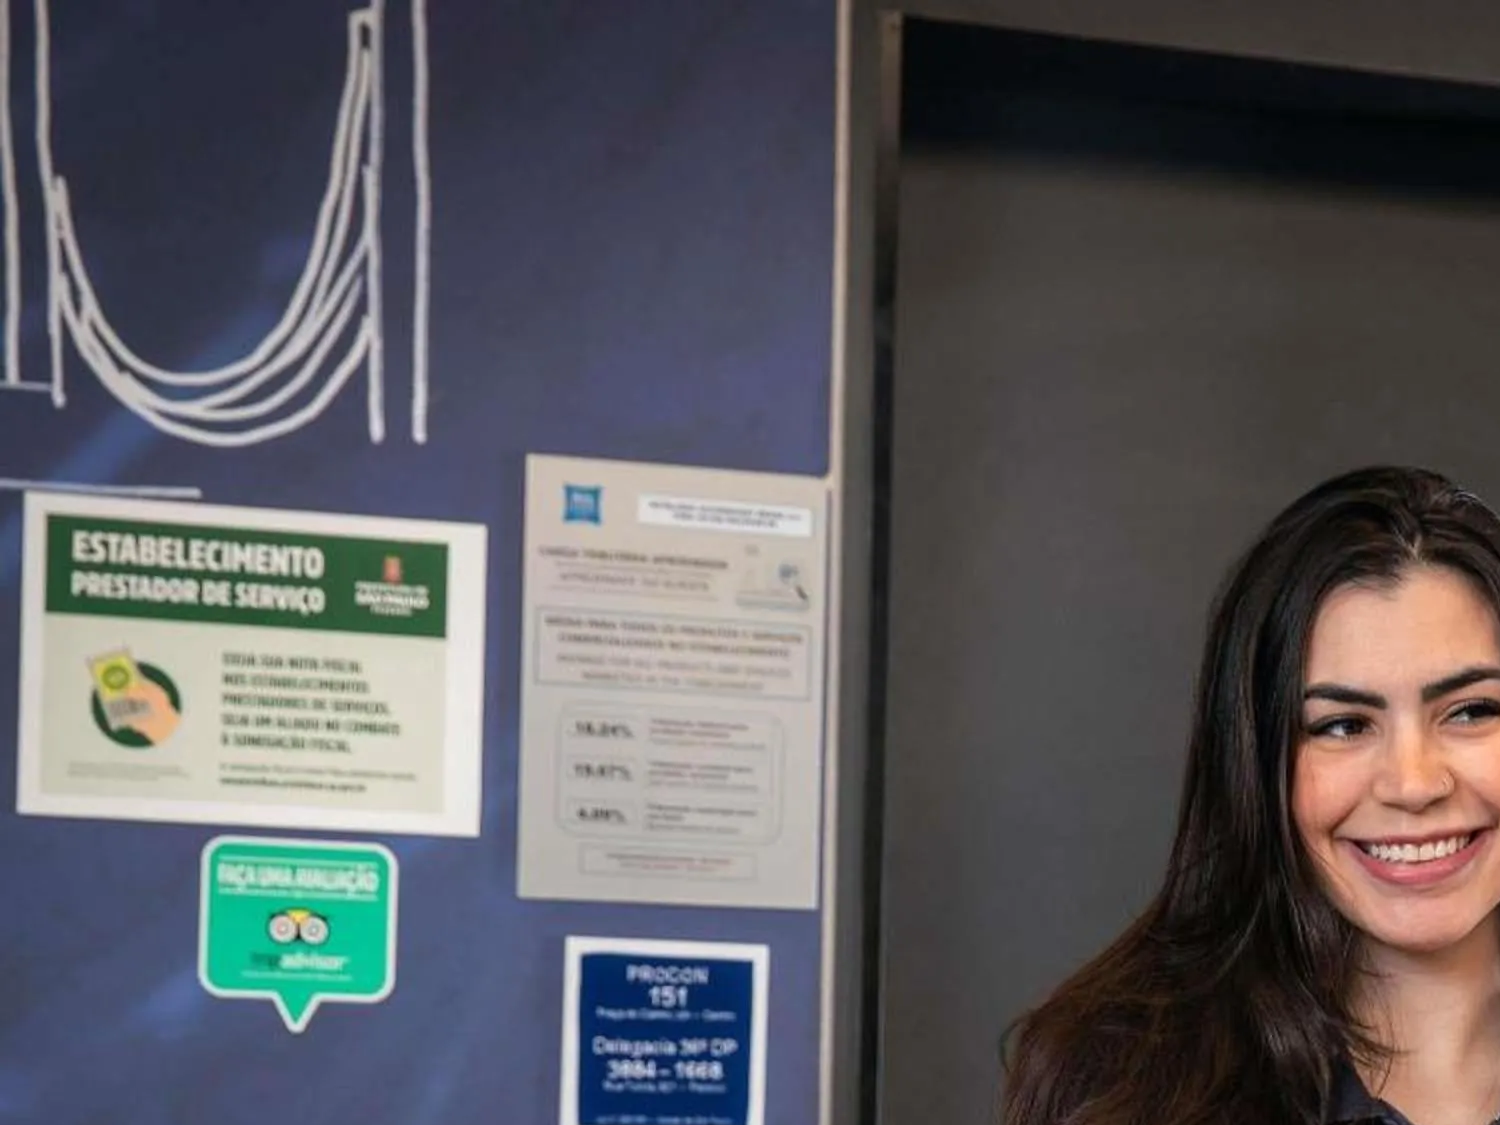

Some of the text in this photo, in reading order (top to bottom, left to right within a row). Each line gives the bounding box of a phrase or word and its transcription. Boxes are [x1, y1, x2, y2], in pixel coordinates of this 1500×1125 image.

[72, 530, 324, 580] ESTABELECIMENTO
[71, 571, 198, 606] PRESTADOR
[201, 578, 231, 608] DE
[235, 582, 325, 615] SERVIÇO
[626, 964, 709, 985] PROCON
[649, 985, 688, 1007] 151
[592, 1036, 677, 1058] Delegacia
